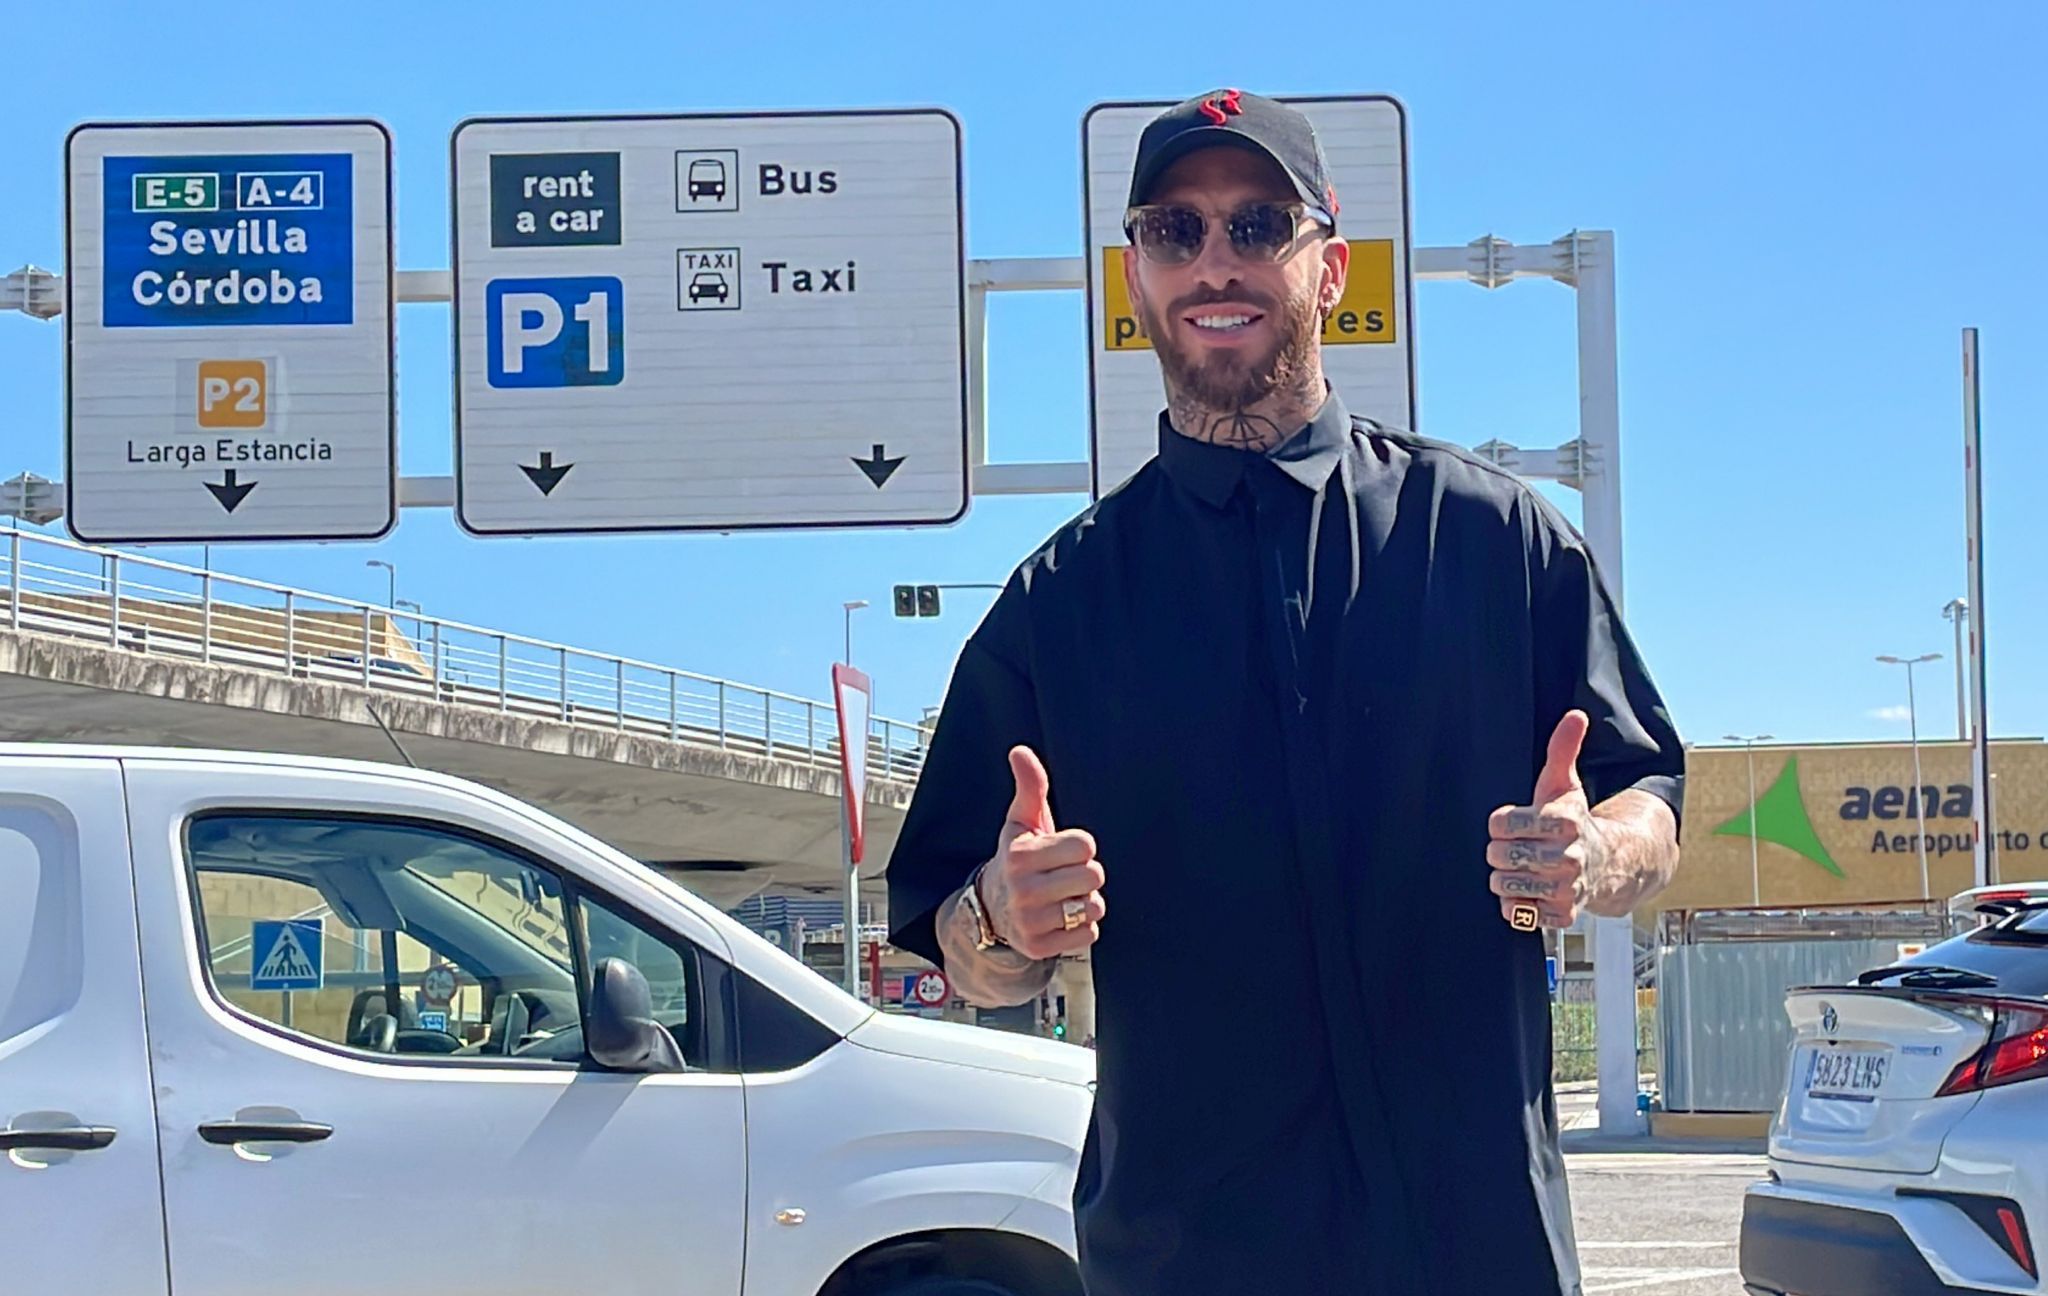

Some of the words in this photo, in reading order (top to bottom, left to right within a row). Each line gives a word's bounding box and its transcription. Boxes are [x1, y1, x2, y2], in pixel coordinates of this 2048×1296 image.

[145, 178, 206, 207] E-5
[246, 176, 314, 206] A-4
[523, 169, 594, 199] rent
[759, 163, 838, 196] Bus
[148, 218, 308, 256] Sevilla
[515, 210, 536, 234] a
[549, 208, 604, 232] car
[685, 253, 733, 270] TAXI
[761, 260, 856, 294] Taxi
[131, 269, 323, 306] Córdoba
[501, 291, 609, 374] P1
[203, 376, 261, 413] P2
[127, 440, 206, 469] Larga
[216, 437, 332, 462] Estancia
[1839, 783, 1974, 820] aena
[1871, 829, 2030, 858] Aeropurto
[1515, 910, 1533, 926] R
[1851, 1055, 1886, 1089] LNS
